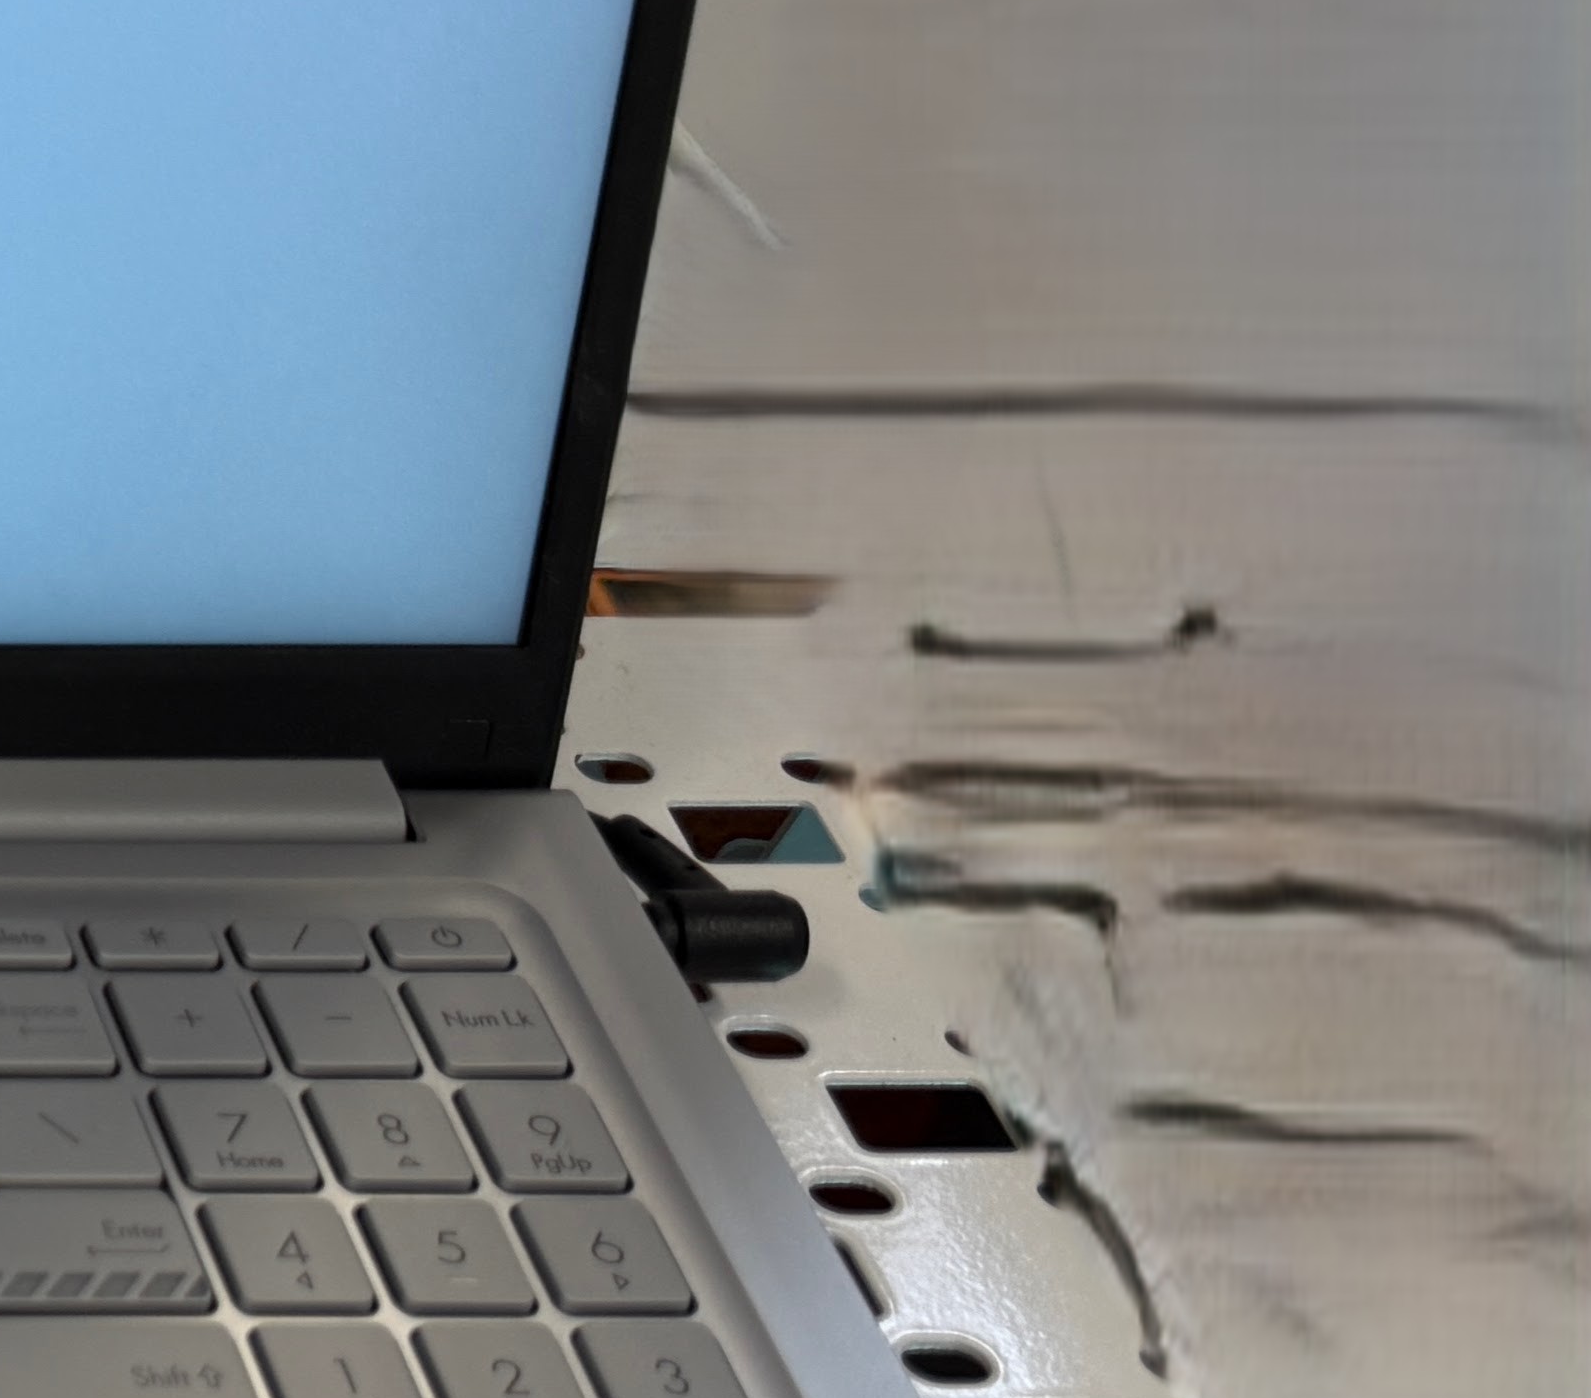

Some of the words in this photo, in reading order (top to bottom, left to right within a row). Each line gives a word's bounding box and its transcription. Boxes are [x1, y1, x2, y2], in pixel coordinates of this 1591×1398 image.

[442, 1008, 498, 1029] Num
[503, 1008, 535, 1029] Lk
[218, 1112, 247, 1144] 7
[377, 1114, 410, 1146] 8
[528, 1114, 561, 1147] 9
[217, 1151, 285, 1170] Home
[530, 1152, 594, 1174] PgUp
[102, 1218, 164, 1242] Enter
[275, 1230, 310, 1264] 4
[437, 1230, 467, 1265] 5
[591, 1230, 626, 1265] 6
[130, 1363, 190, 1389] Shift
[333, 1357, 359, 1395] 1
[491, 1359, 531, 1397] 2
[655, 1358, 691, 1396] 3
